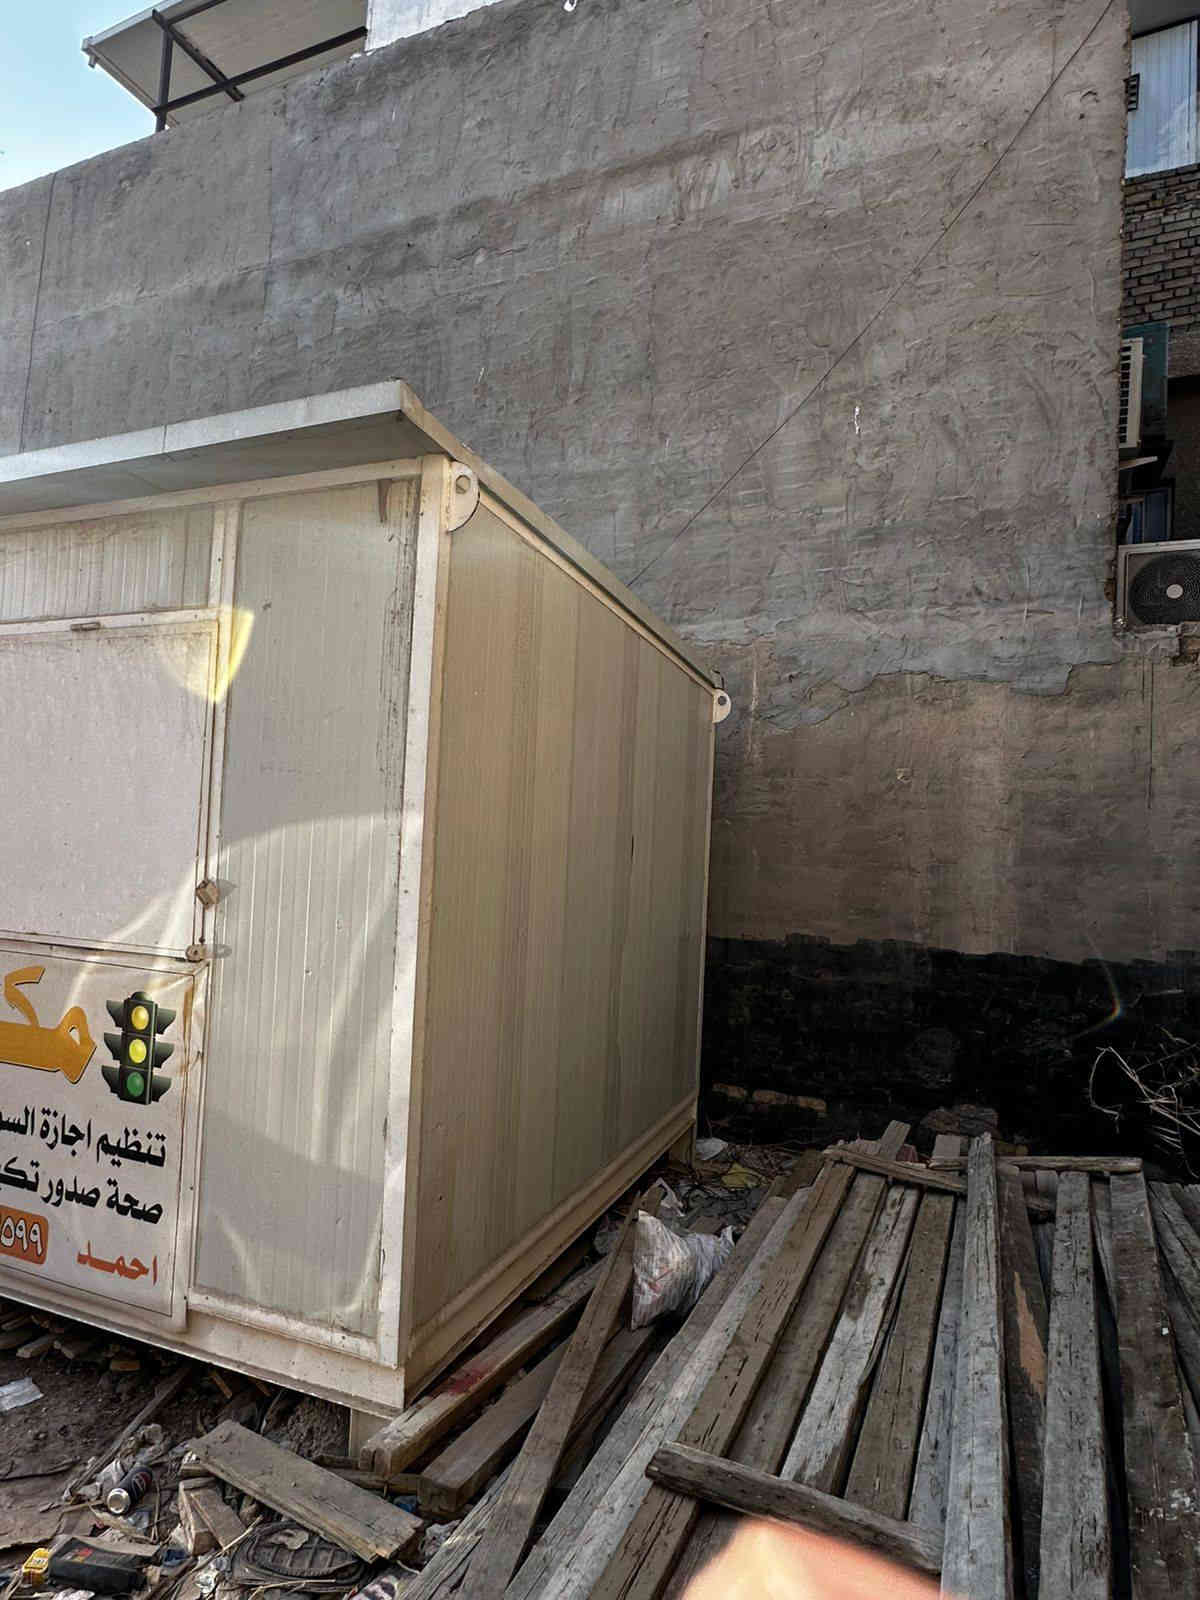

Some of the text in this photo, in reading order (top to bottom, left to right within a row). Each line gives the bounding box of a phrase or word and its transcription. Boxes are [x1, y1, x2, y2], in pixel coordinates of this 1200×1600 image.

[0, 965, 97, 1084] مك
[0, 1105, 166, 1167] تنظيم اجازة الس
[0, 1156, 163, 1224] صحة صدور تك
[0, 1216, 43, 1257] ٥٩٩
[77, 1240, 158, 1285] احمد
